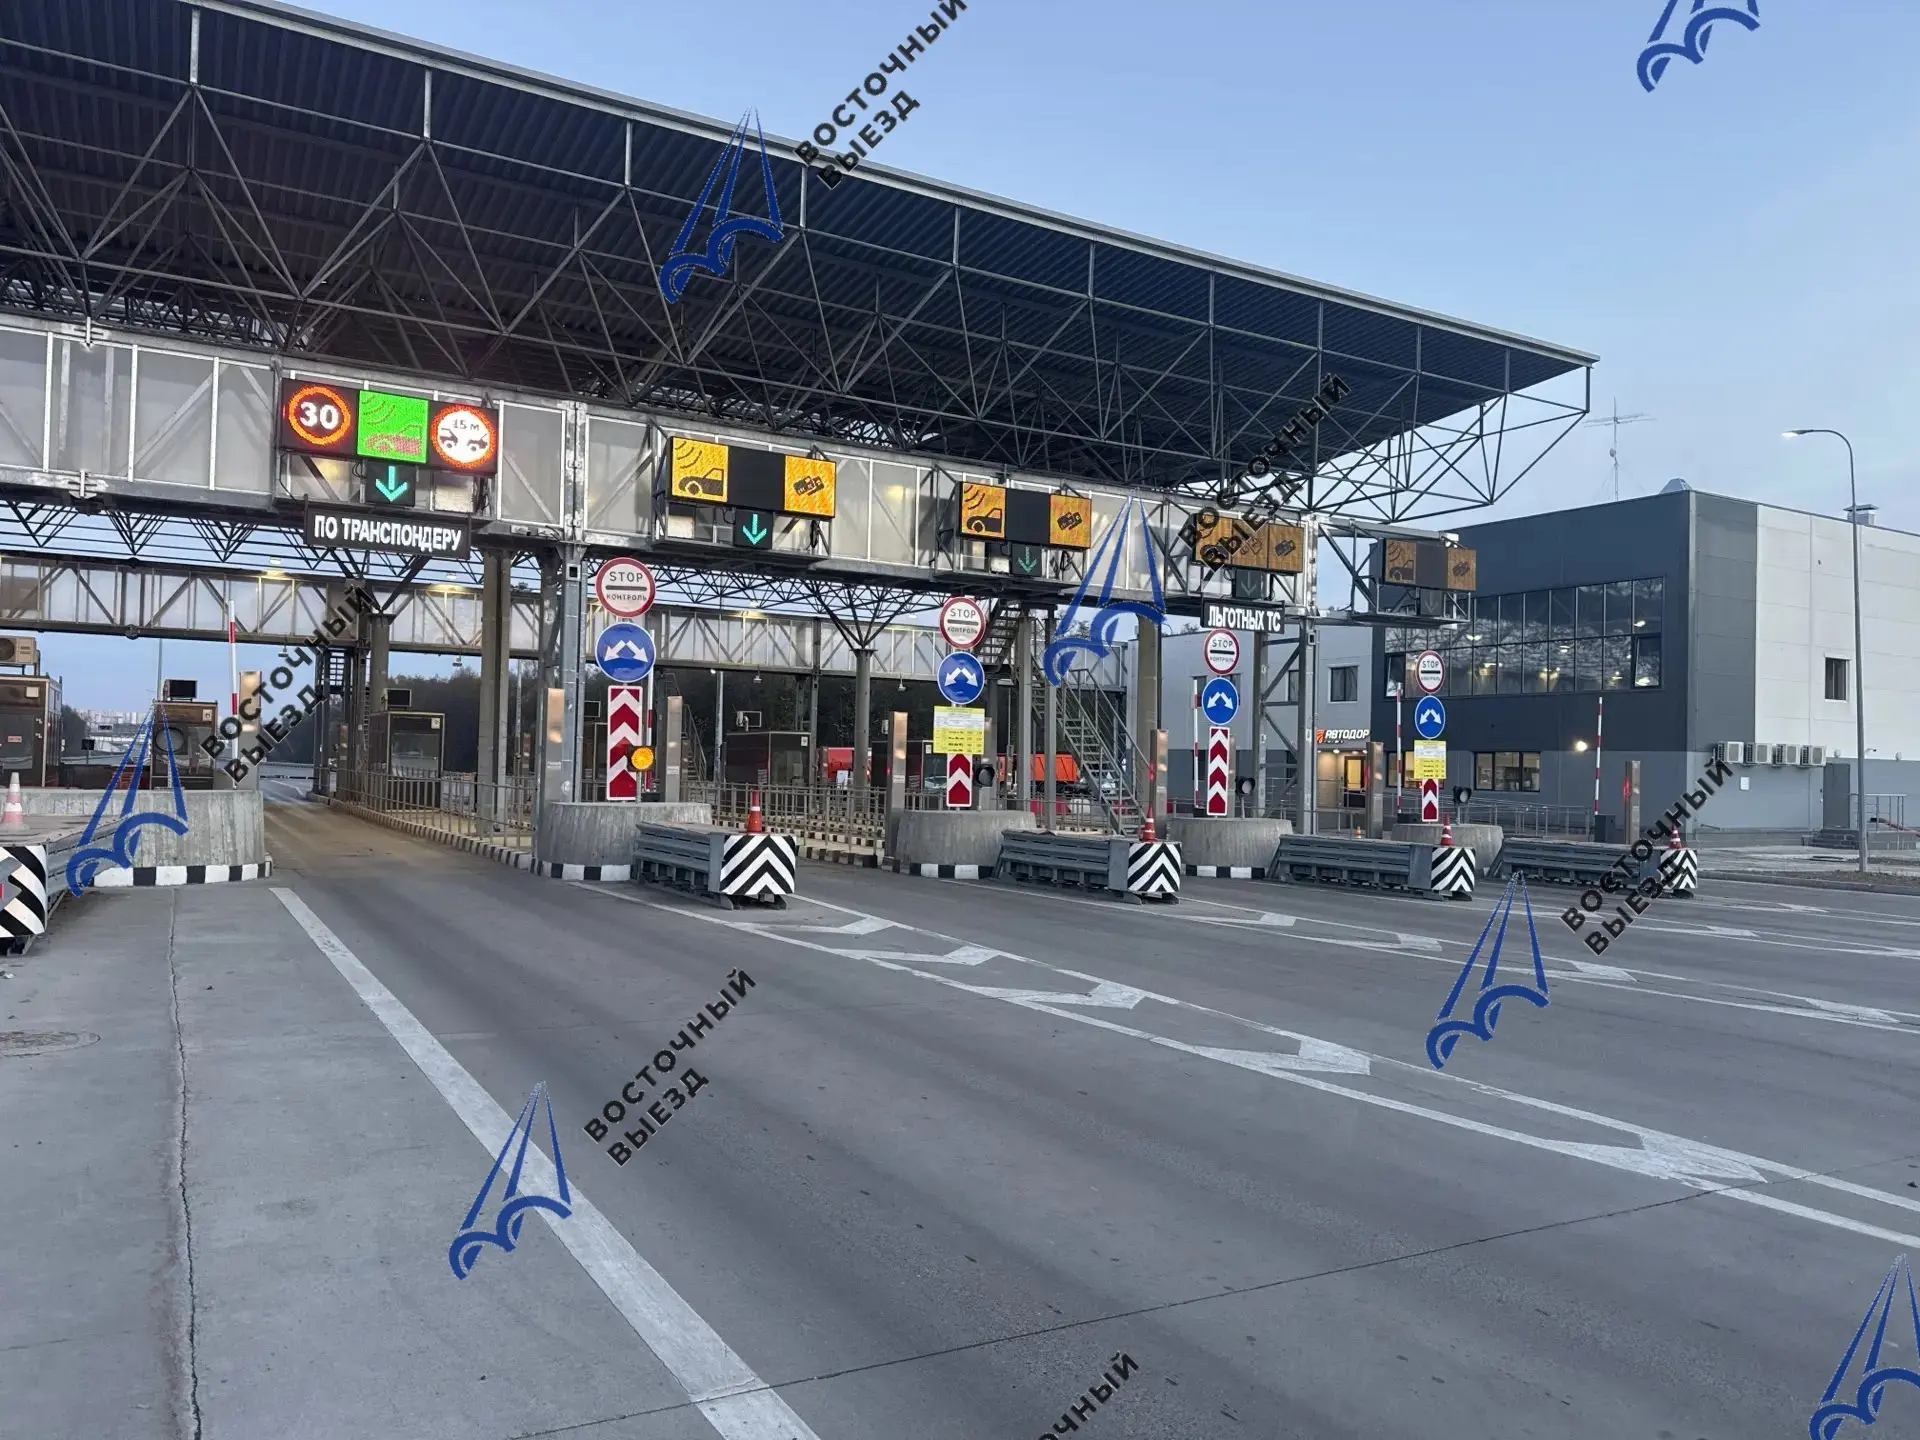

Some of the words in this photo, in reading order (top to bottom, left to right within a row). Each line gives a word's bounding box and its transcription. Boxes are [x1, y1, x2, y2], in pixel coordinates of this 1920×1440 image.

[300, 402, 339, 430] 30
[314, 515, 338, 540] ПО
[342, 517, 462, 552] ТРАНСПОНДЕРУ
[609, 571, 643, 582] STOP
[950, 608, 976, 618] STOP
[1208, 606, 1264, 630] ЛЬГОТНЫХ
[1267, 611, 1281, 632] ТС
[1212, 639, 1233, 648] STOP
[1422, 661, 1439, 669] STOP
[1325, 729, 1370, 740] АВТОДОР
